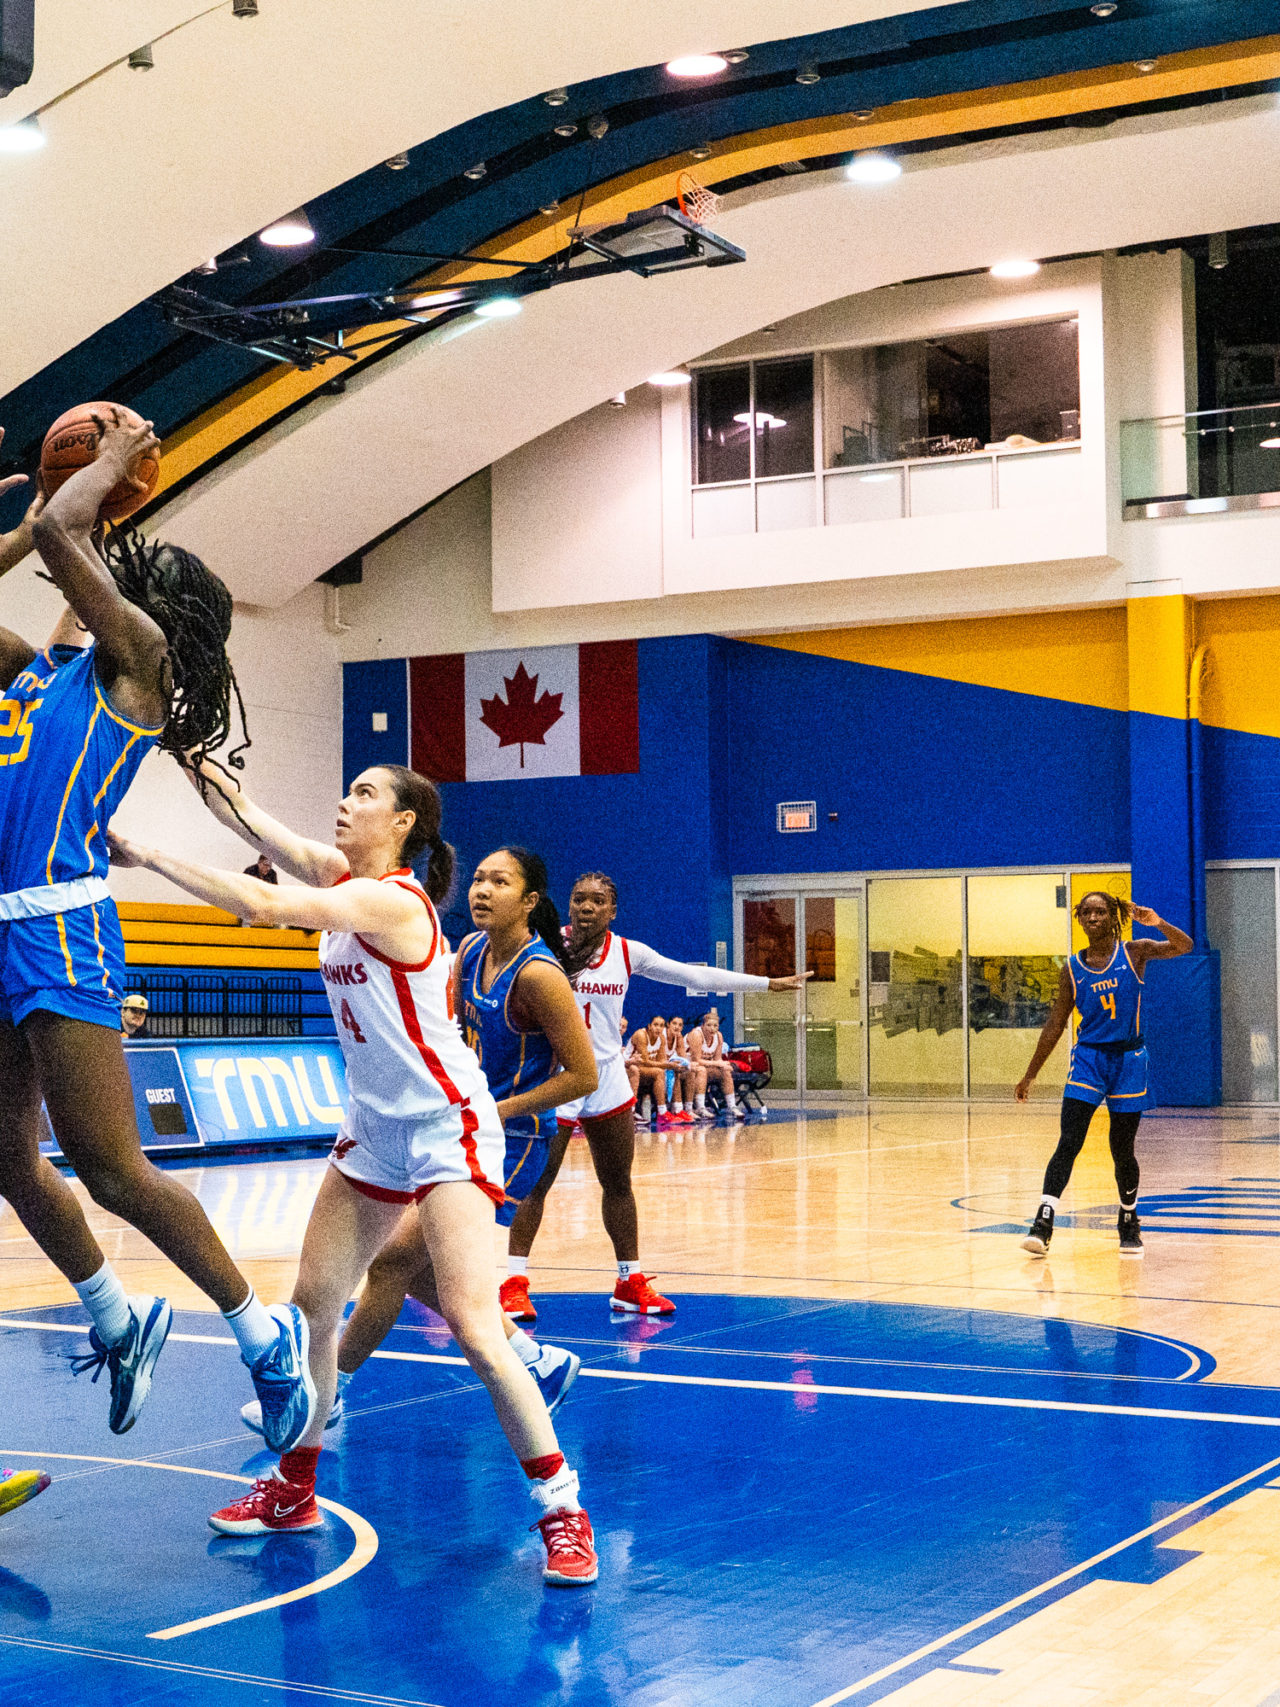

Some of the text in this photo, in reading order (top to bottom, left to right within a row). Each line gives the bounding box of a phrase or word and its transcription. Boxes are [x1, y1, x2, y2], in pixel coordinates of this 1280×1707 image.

[12, 671, 58, 693] MU
[1090, 977, 1119, 993] TMU
[1099, 992, 1117, 1020] 4
[145, 1088, 177, 1104] GUEST
[195, 1056, 346, 1130] TMU
